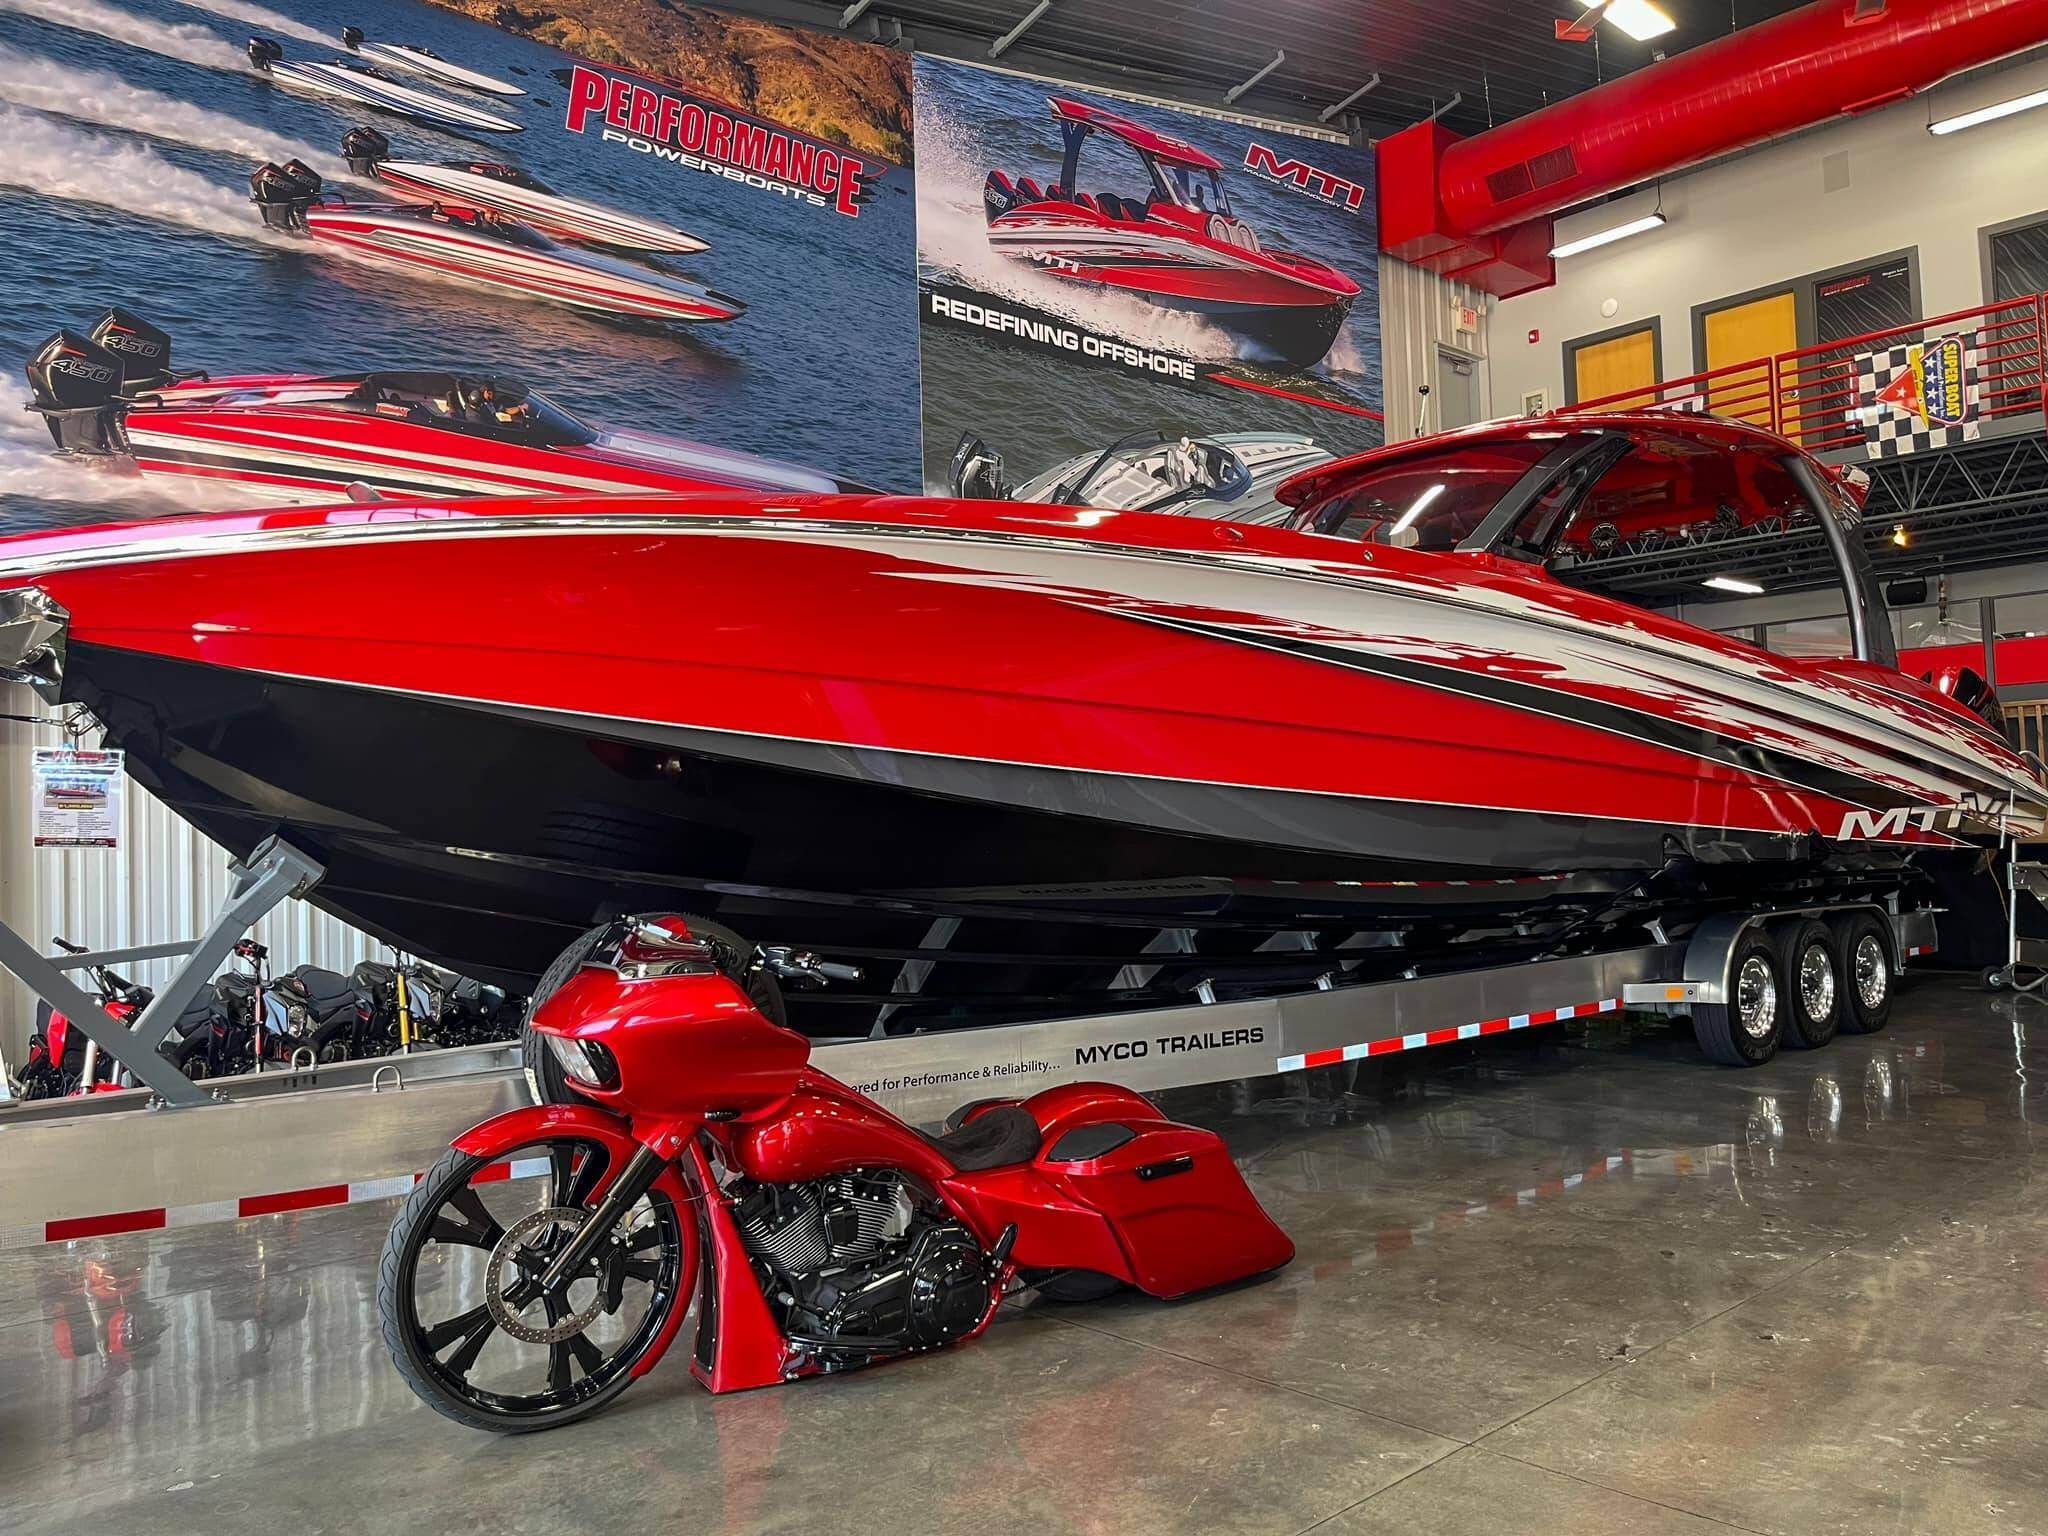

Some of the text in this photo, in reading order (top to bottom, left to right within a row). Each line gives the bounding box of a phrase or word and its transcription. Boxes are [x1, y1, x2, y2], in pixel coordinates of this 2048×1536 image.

[565, 65, 864, 218] PERFORMANCE
[602, 129, 826, 207] POWERBOATS
[1243, 142, 1365, 209] MTI
[1243, 167, 1280, 185] MARINE
[1283, 182, 1342, 208] TECHNOLOGY
[1022, 246, 1079, 273] MTI
[1463, 309, 1474, 326] EXIT
[103, 335, 161, 358] 450
[931, 294, 1196, 381] REDEFINING OFFSHORE
[51, 359, 113, 384] 450
[1942, 343, 1961, 417] SUPER BOAT
[1836, 802, 1969, 841] MTI
[1075, 1027, 1264, 1065] MYCO TRAILERS
[848, 1079, 879, 1095] ered
[883, 1077, 901, 1090] for
[903, 1069, 980, 1087] Performance
[982, 1066, 992, 1078] &
